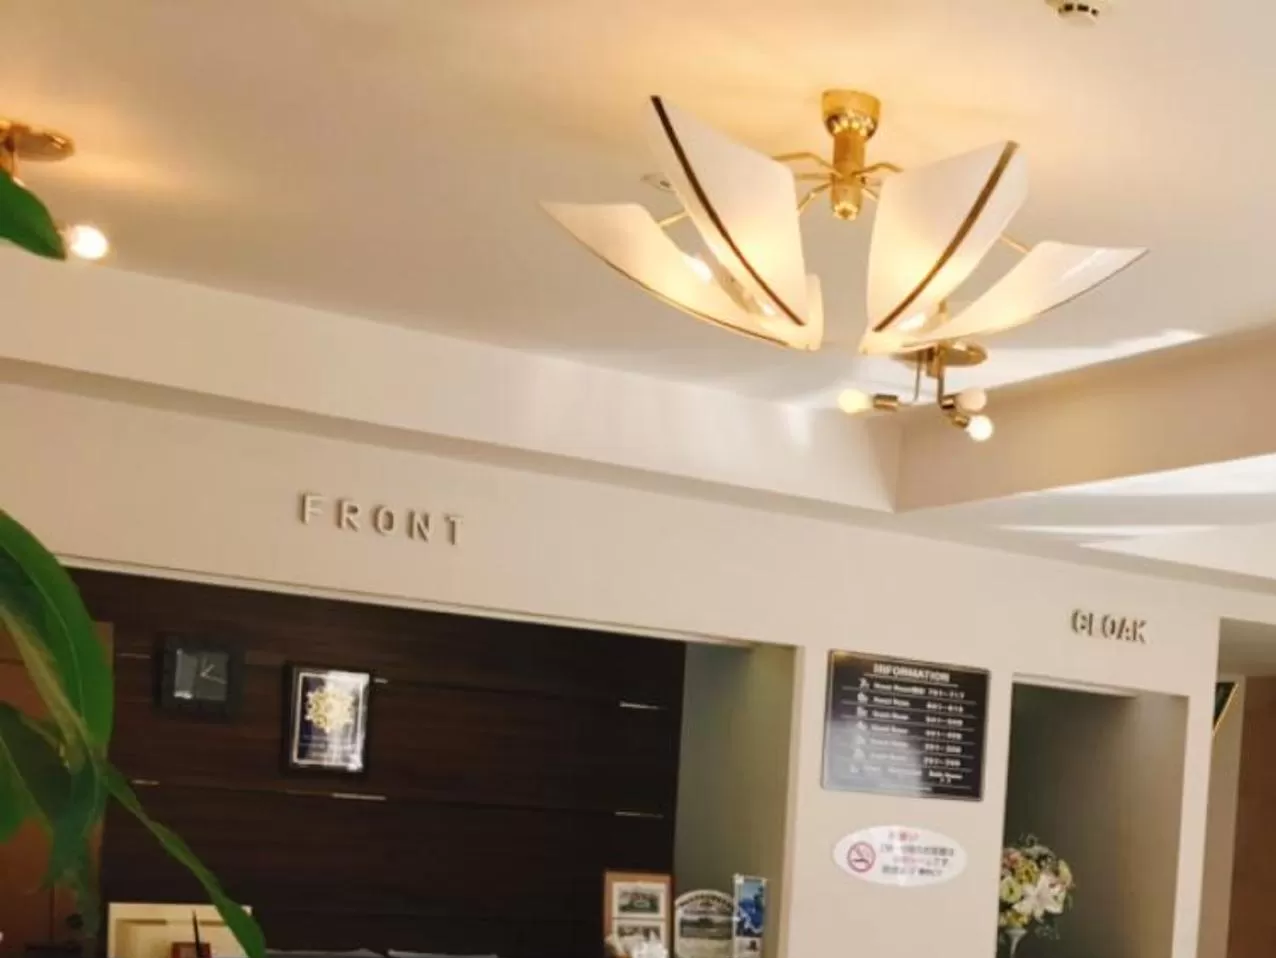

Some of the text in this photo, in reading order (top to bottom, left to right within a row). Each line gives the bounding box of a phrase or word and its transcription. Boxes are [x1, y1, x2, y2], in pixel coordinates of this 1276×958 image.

[297, 490, 464, 546] FRONT
[1071, 608, 1147, 645] CLOAK
[873, 663, 950, 682] INFORMATION
